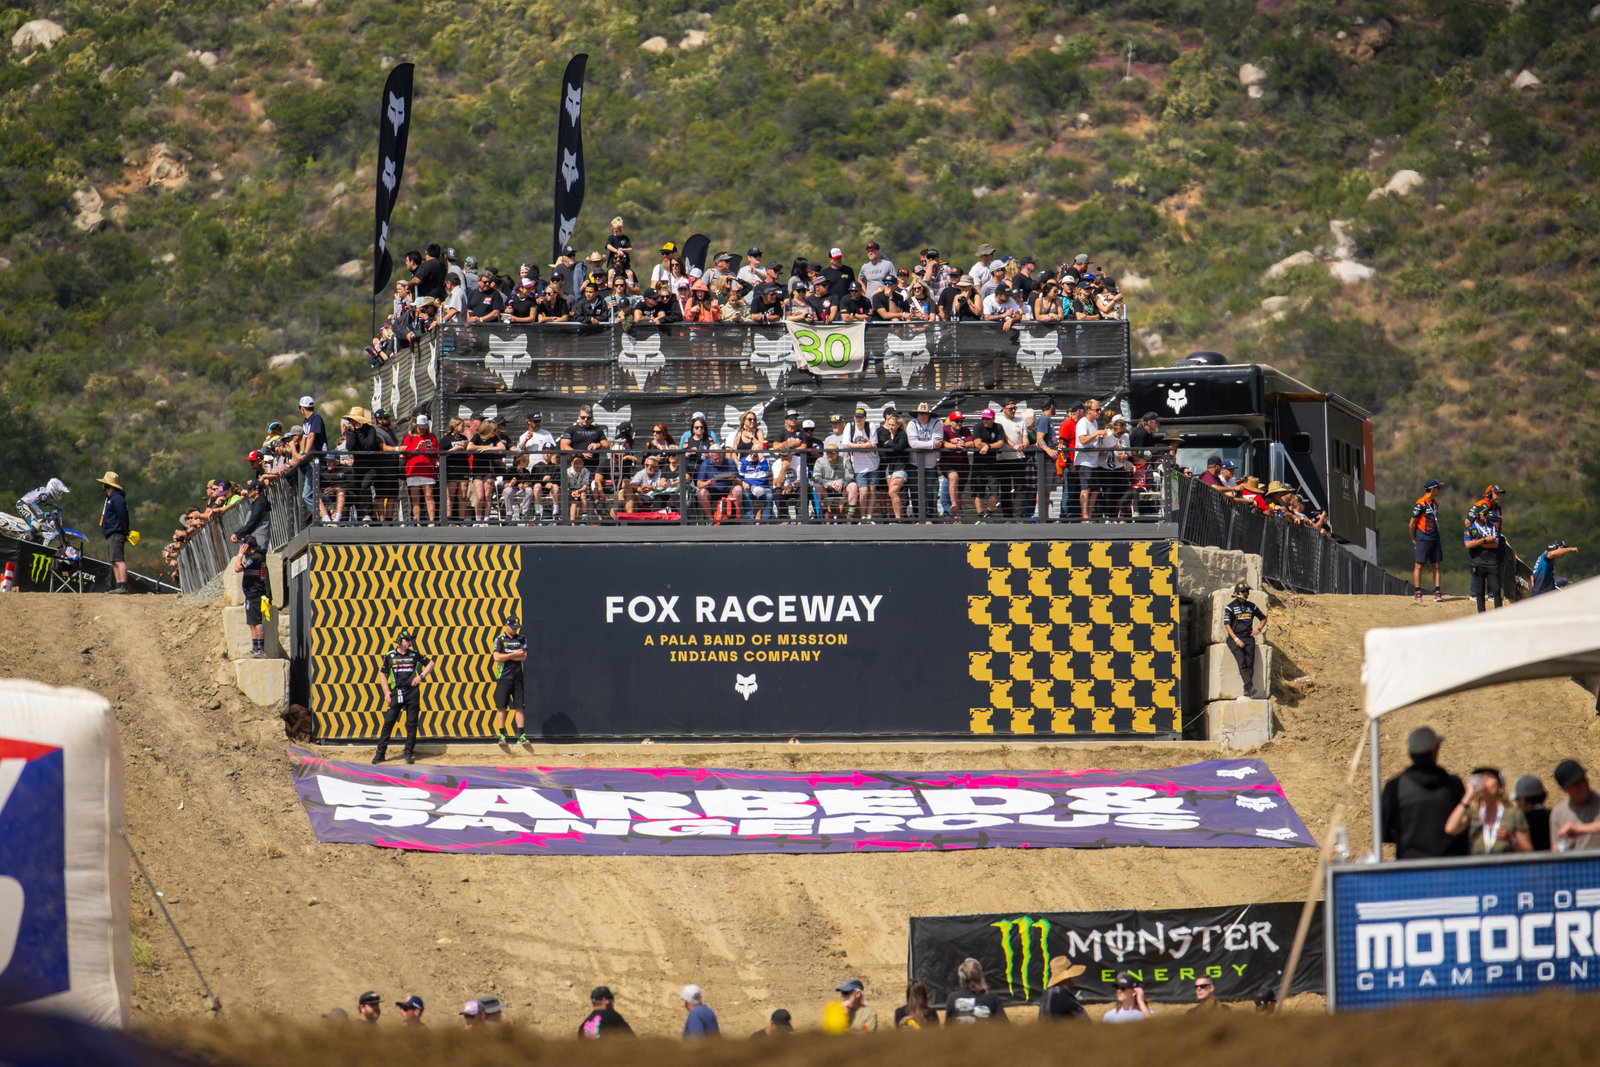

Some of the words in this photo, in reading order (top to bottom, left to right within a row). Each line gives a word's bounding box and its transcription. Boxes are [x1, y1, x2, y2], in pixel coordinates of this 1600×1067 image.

[794, 329, 852, 368] 30
[605, 595, 681, 623] FOX
[695, 594, 883, 623] RACEWAY
[643, 634, 655, 646] A
[660, 634, 698, 646] PALA
[703, 634, 746, 646] BAND
[750, 634, 772, 646] OF
[777, 633, 849, 646] MISSION
[670, 650, 739, 663] INDIANS
[743, 650, 822, 662] COMPANY
[333, 806, 1201, 836] DANGEROUS
[1482, 889, 1573, 912] PRO
[1066, 920, 1280, 963] MONSTER
[1355, 910, 1600, 971] MOTOCR
[1101, 963, 1248, 983] ENERGY
